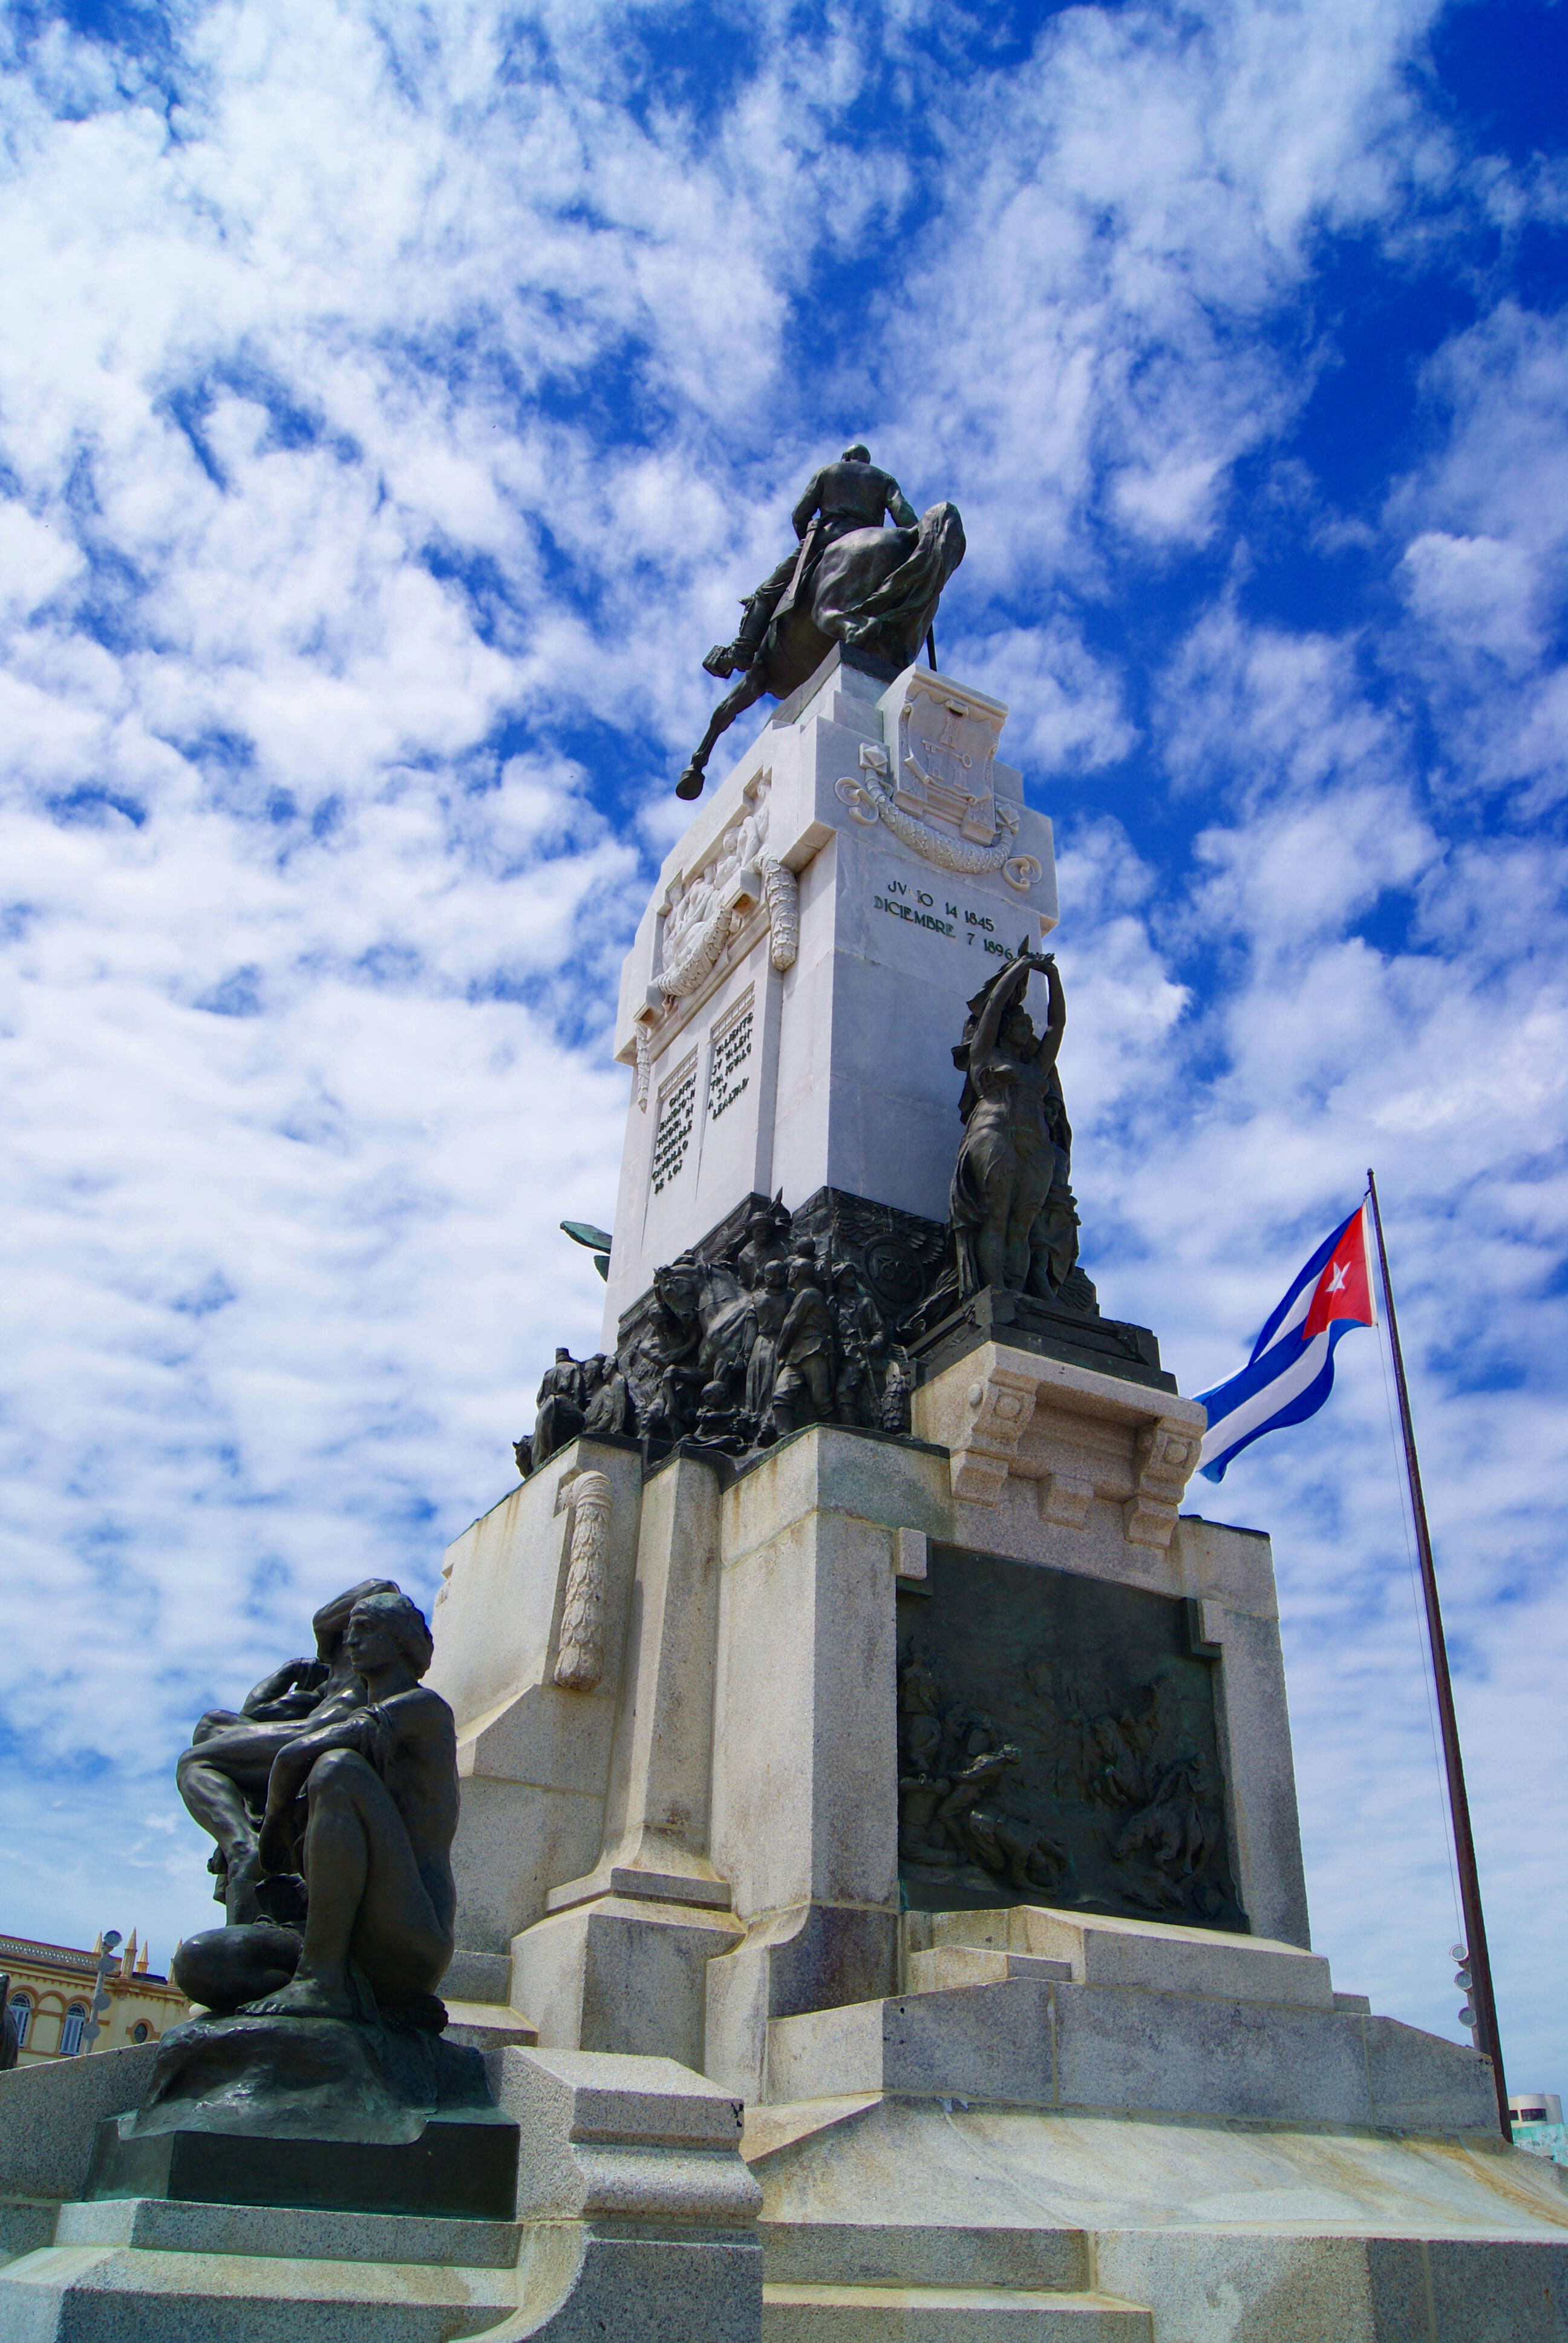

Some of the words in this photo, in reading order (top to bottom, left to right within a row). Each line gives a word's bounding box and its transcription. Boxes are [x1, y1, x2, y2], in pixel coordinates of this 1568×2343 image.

[874, 895, 956, 939] DICIEMBRE
[967, 932, 976, 946] 7
[984, 938, 1014, 961] 1896
[888, 880, 933, 906] JVIO
[945, 902, 958, 919] 14
[964, 909, 995, 932] 1845
[716, 1009, 754, 1057] VALIENTE
[707, 1099, 714, 1110] A
[654, 1178, 664, 1194] DE
[667, 1159, 683, 1181] LOS
